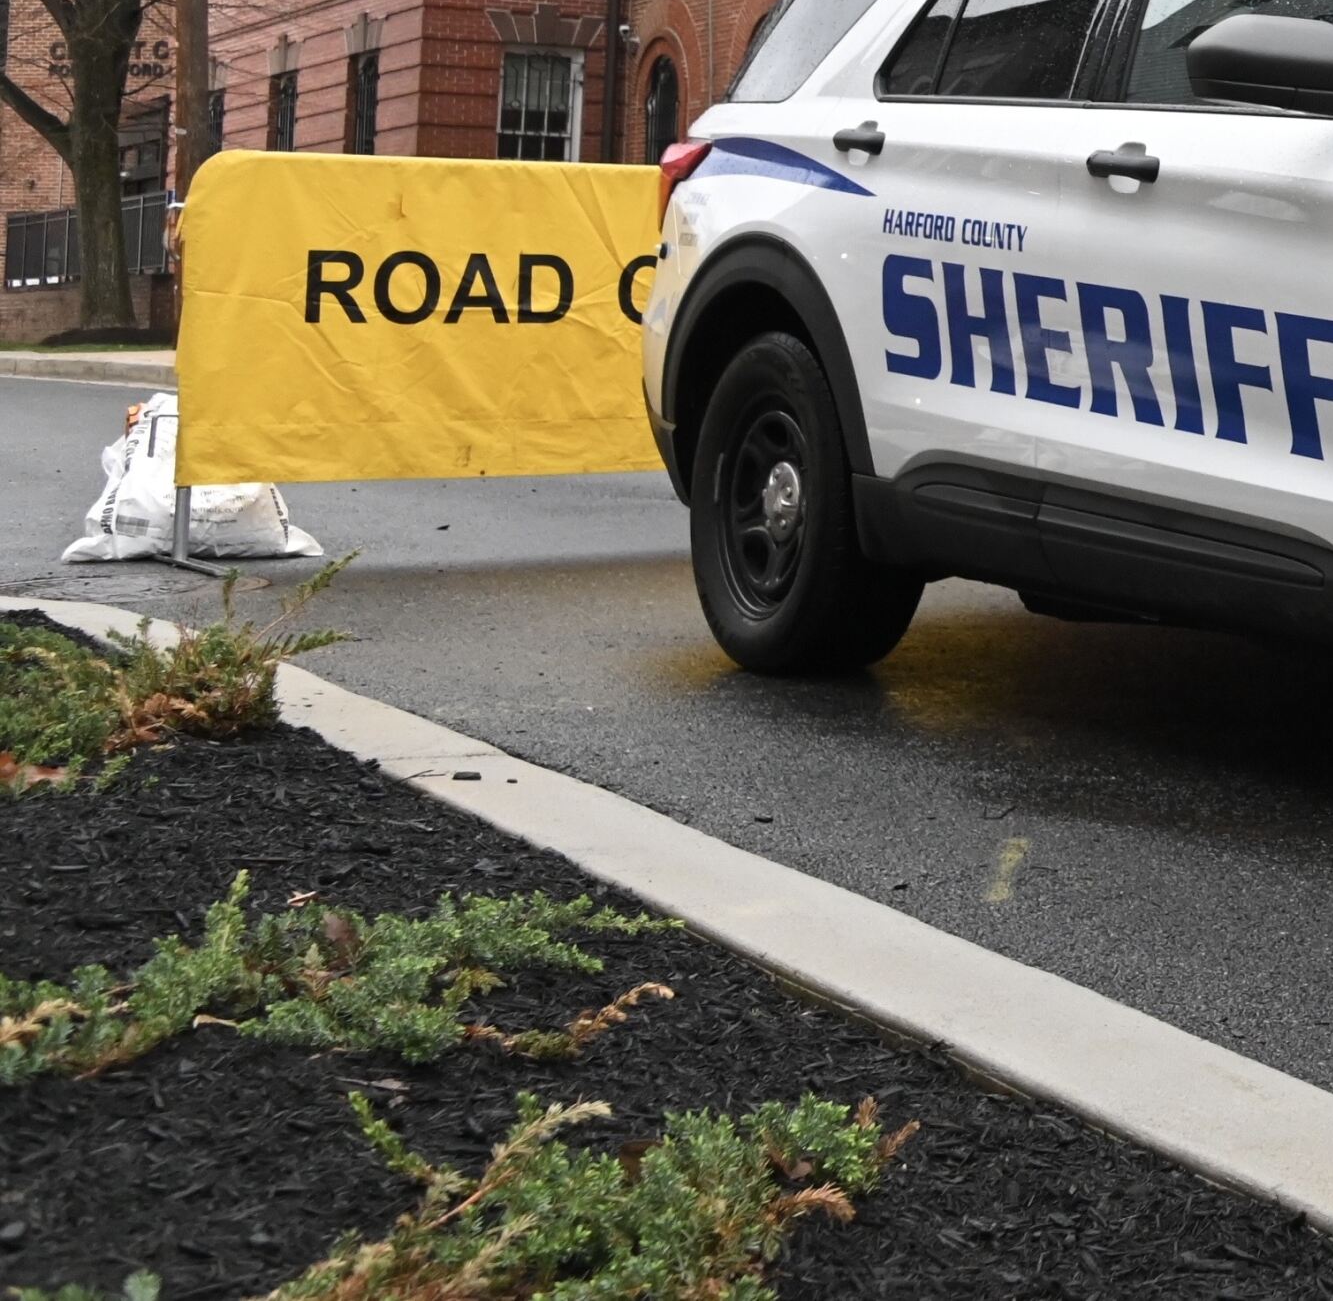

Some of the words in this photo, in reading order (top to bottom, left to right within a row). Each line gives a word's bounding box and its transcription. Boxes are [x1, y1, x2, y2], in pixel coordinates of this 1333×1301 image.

[882, 208, 956, 243] HARFORD
[961, 218, 1028, 252] COUNTY
[304, 249, 574, 325] ROAD
